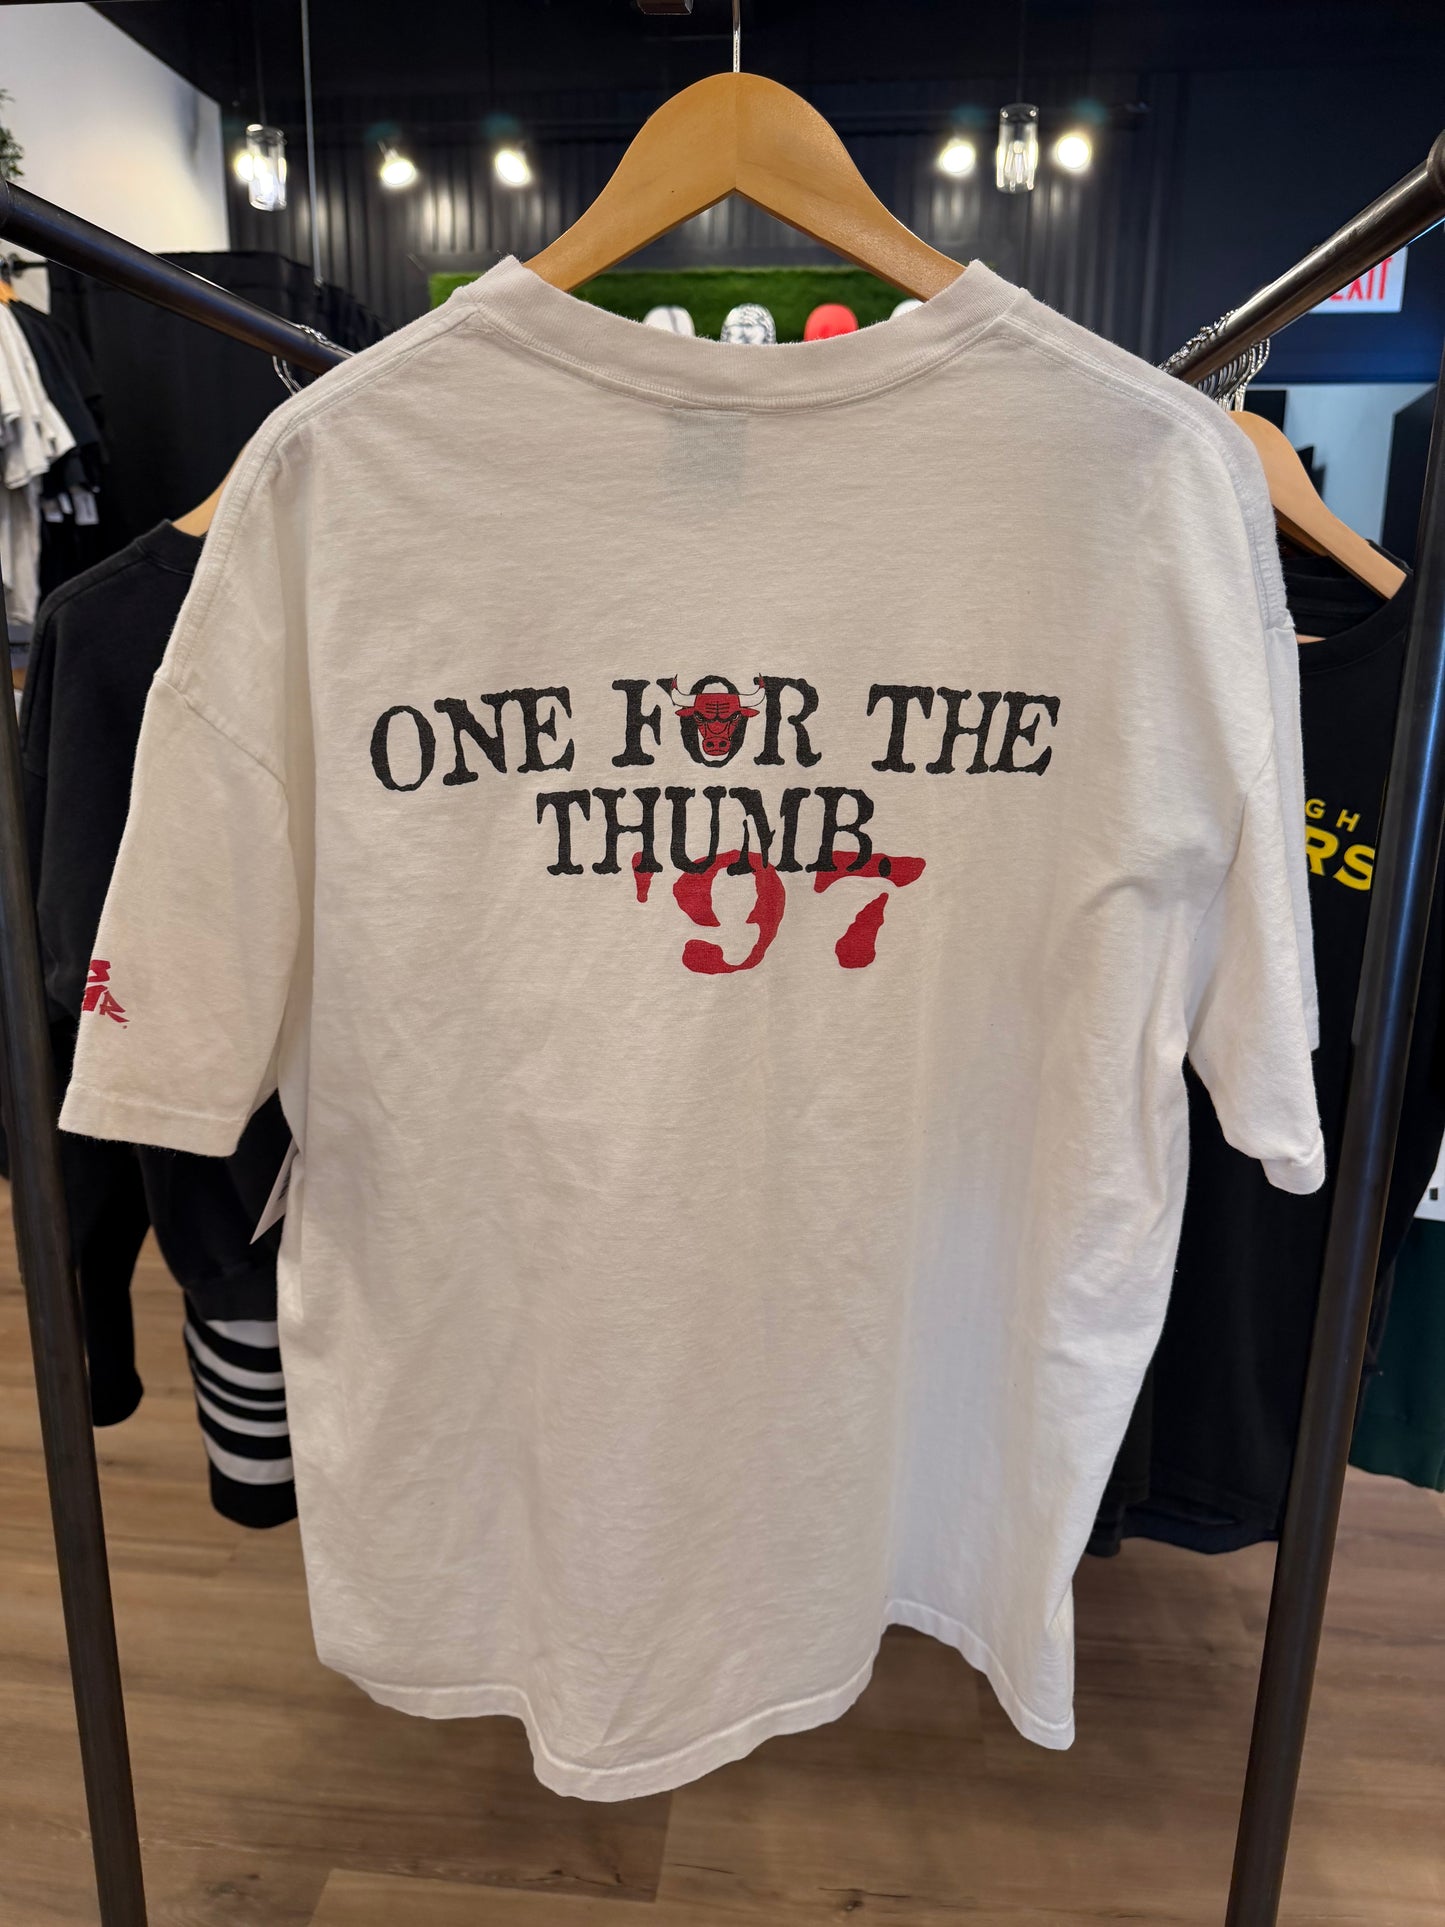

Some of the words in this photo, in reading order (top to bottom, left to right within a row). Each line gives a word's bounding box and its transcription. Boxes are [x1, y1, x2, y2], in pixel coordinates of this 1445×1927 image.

[369, 685, 575, 792] ONE
[611, 674, 822, 768] FOR
[867, 683, 1061, 777] THE
